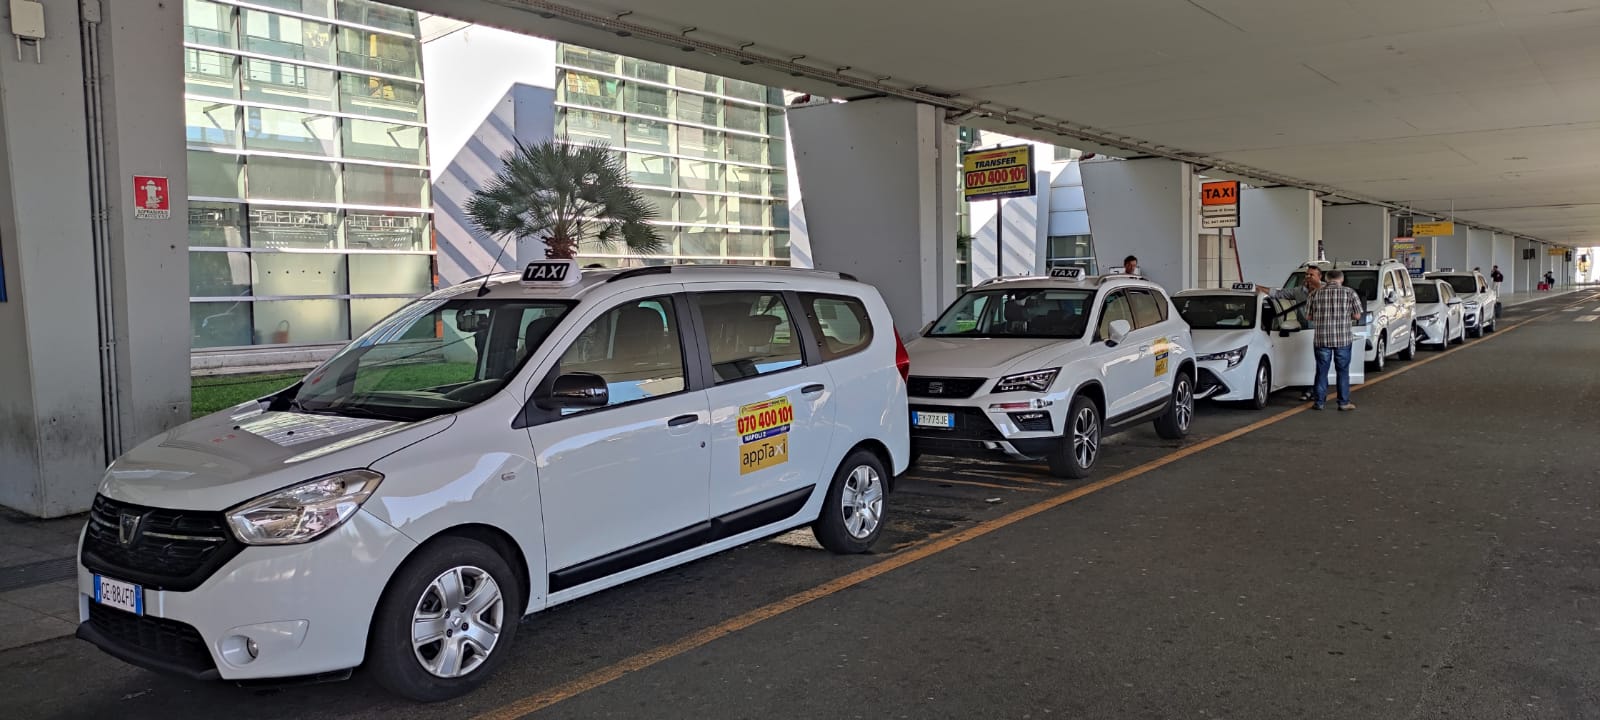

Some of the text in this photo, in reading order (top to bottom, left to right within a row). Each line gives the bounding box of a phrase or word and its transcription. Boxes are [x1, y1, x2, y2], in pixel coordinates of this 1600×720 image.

[975, 157, 1016, 168] TRANSFER
[967, 167, 1026, 186] 070 400 101
[1204, 187, 1234, 199] TAXI
[527, 265, 567, 279] TAXI
[1053, 269, 1078, 277] TAXI
[737, 415, 756, 434] 070
[758, 409, 777, 428] 400
[778, 405, 793, 424] 101
[744, 432, 763, 441] NAPOLI
[743, 439, 786, 467] appTaxi
